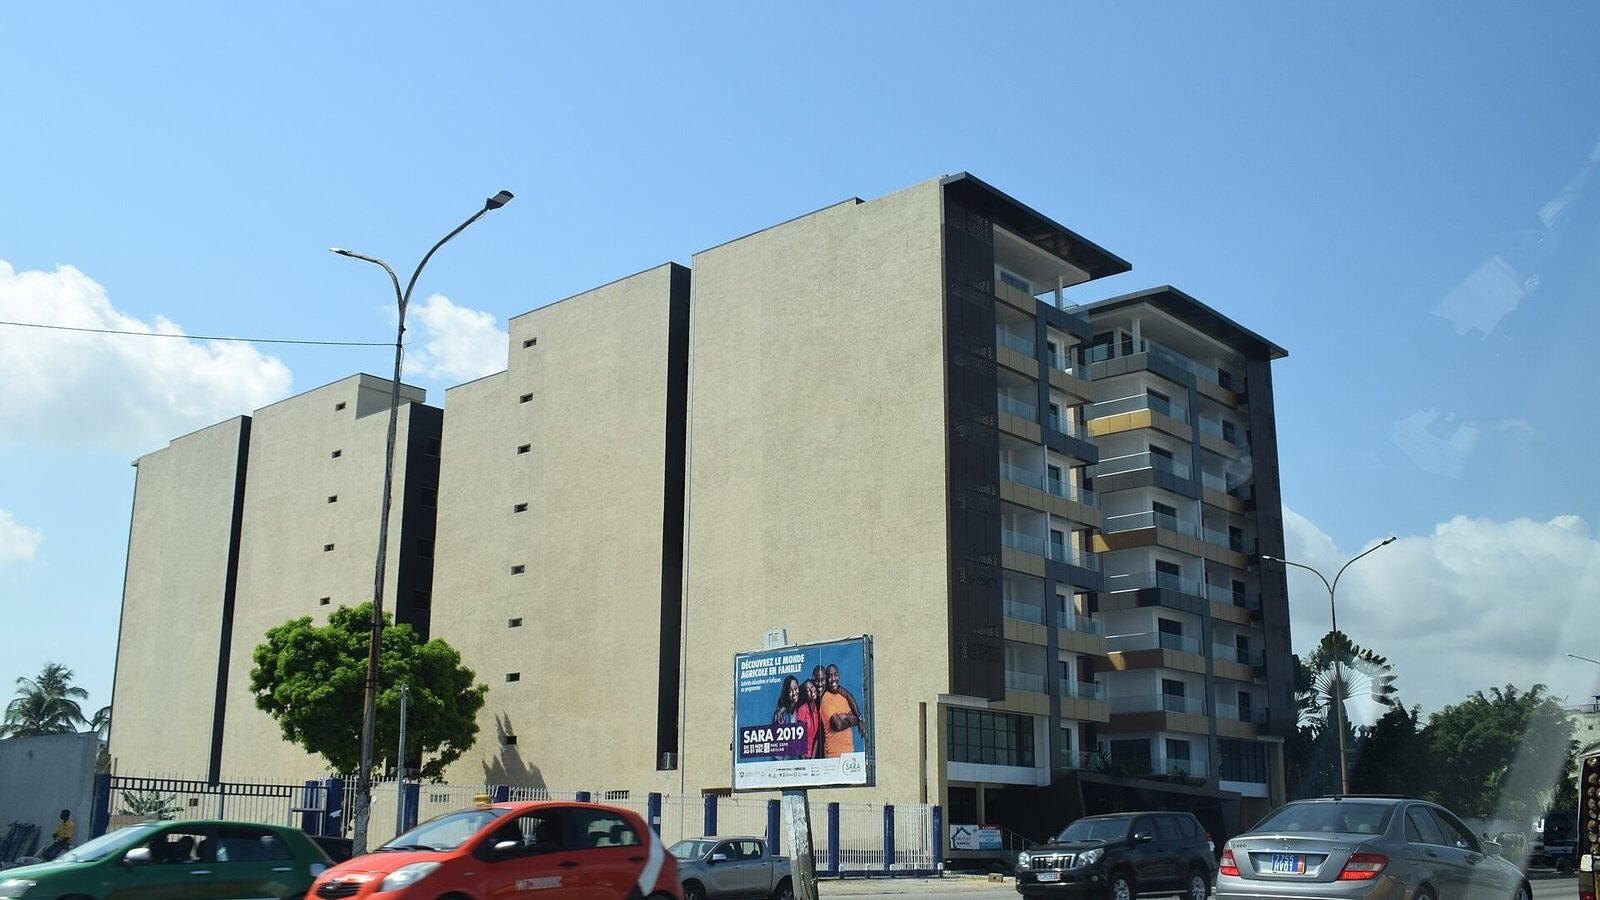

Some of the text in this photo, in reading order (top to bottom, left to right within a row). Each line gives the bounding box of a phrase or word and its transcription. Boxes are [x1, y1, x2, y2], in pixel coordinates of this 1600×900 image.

[741, 654, 804, 670] DÉCOUVREZ LE MONDE
[741, 663, 802, 679] AGRICOLE EN FAMILLE
[743, 726, 804, 744] SARA 2019
